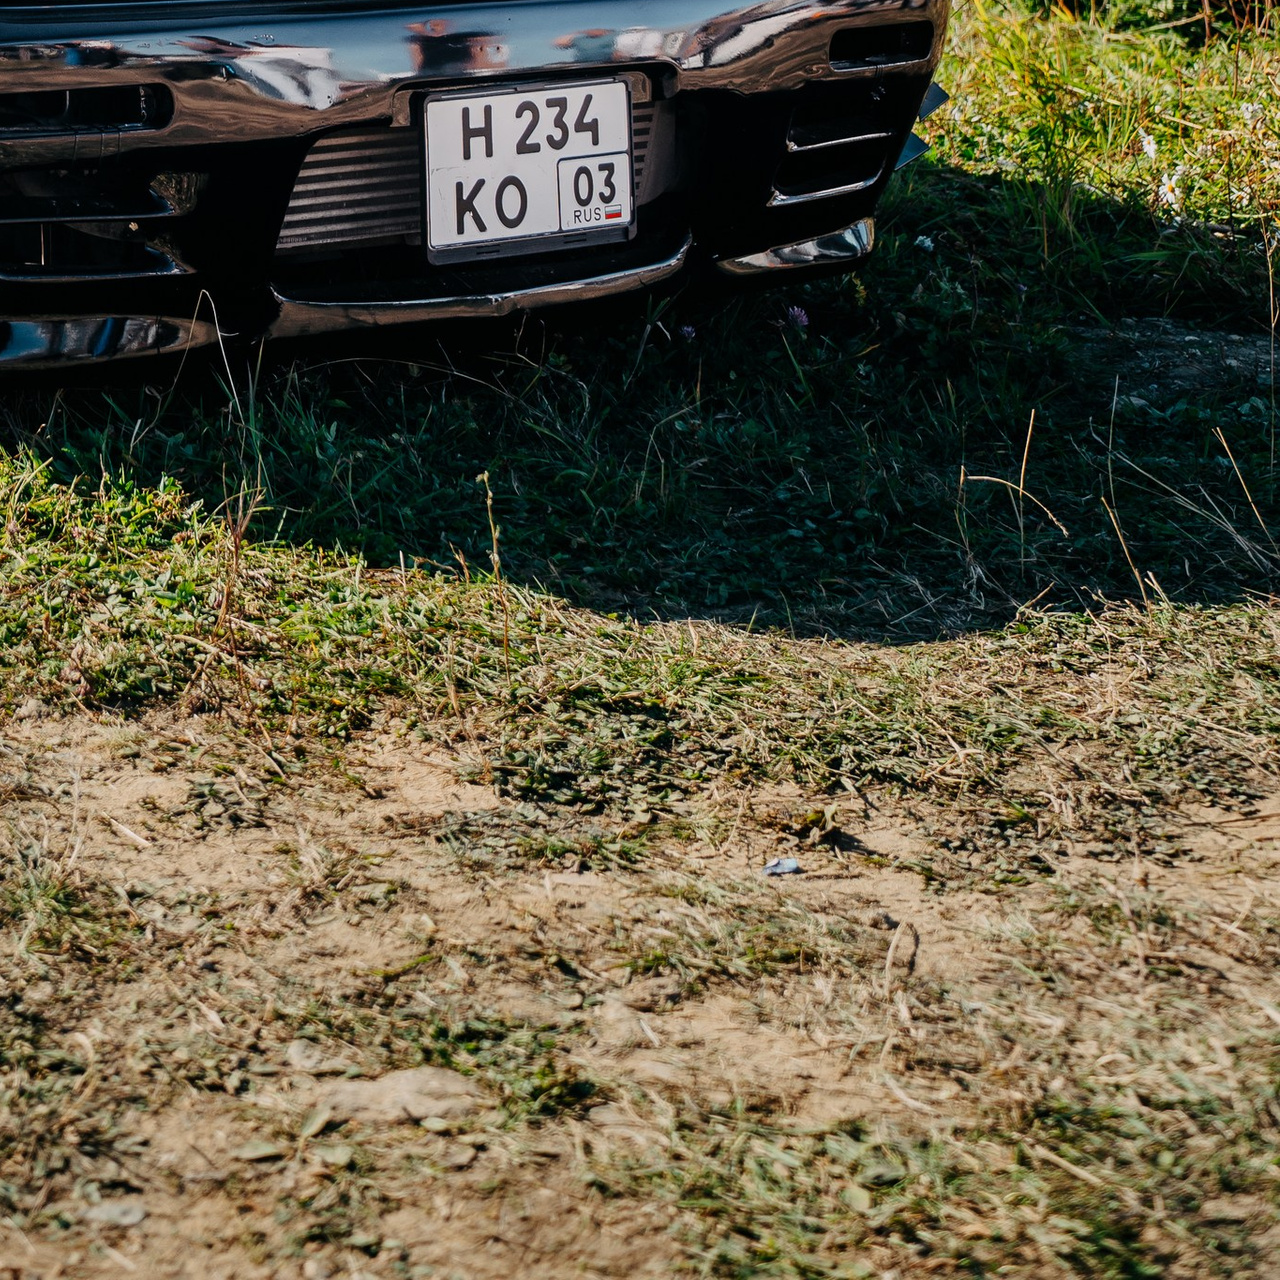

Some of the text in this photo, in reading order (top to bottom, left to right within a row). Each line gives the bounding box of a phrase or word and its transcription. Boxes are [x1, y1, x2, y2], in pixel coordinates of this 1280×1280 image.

[515, 93, 600, 155] 234
[573, 162, 616, 207] 03
[573, 207, 602, 224] RUS
